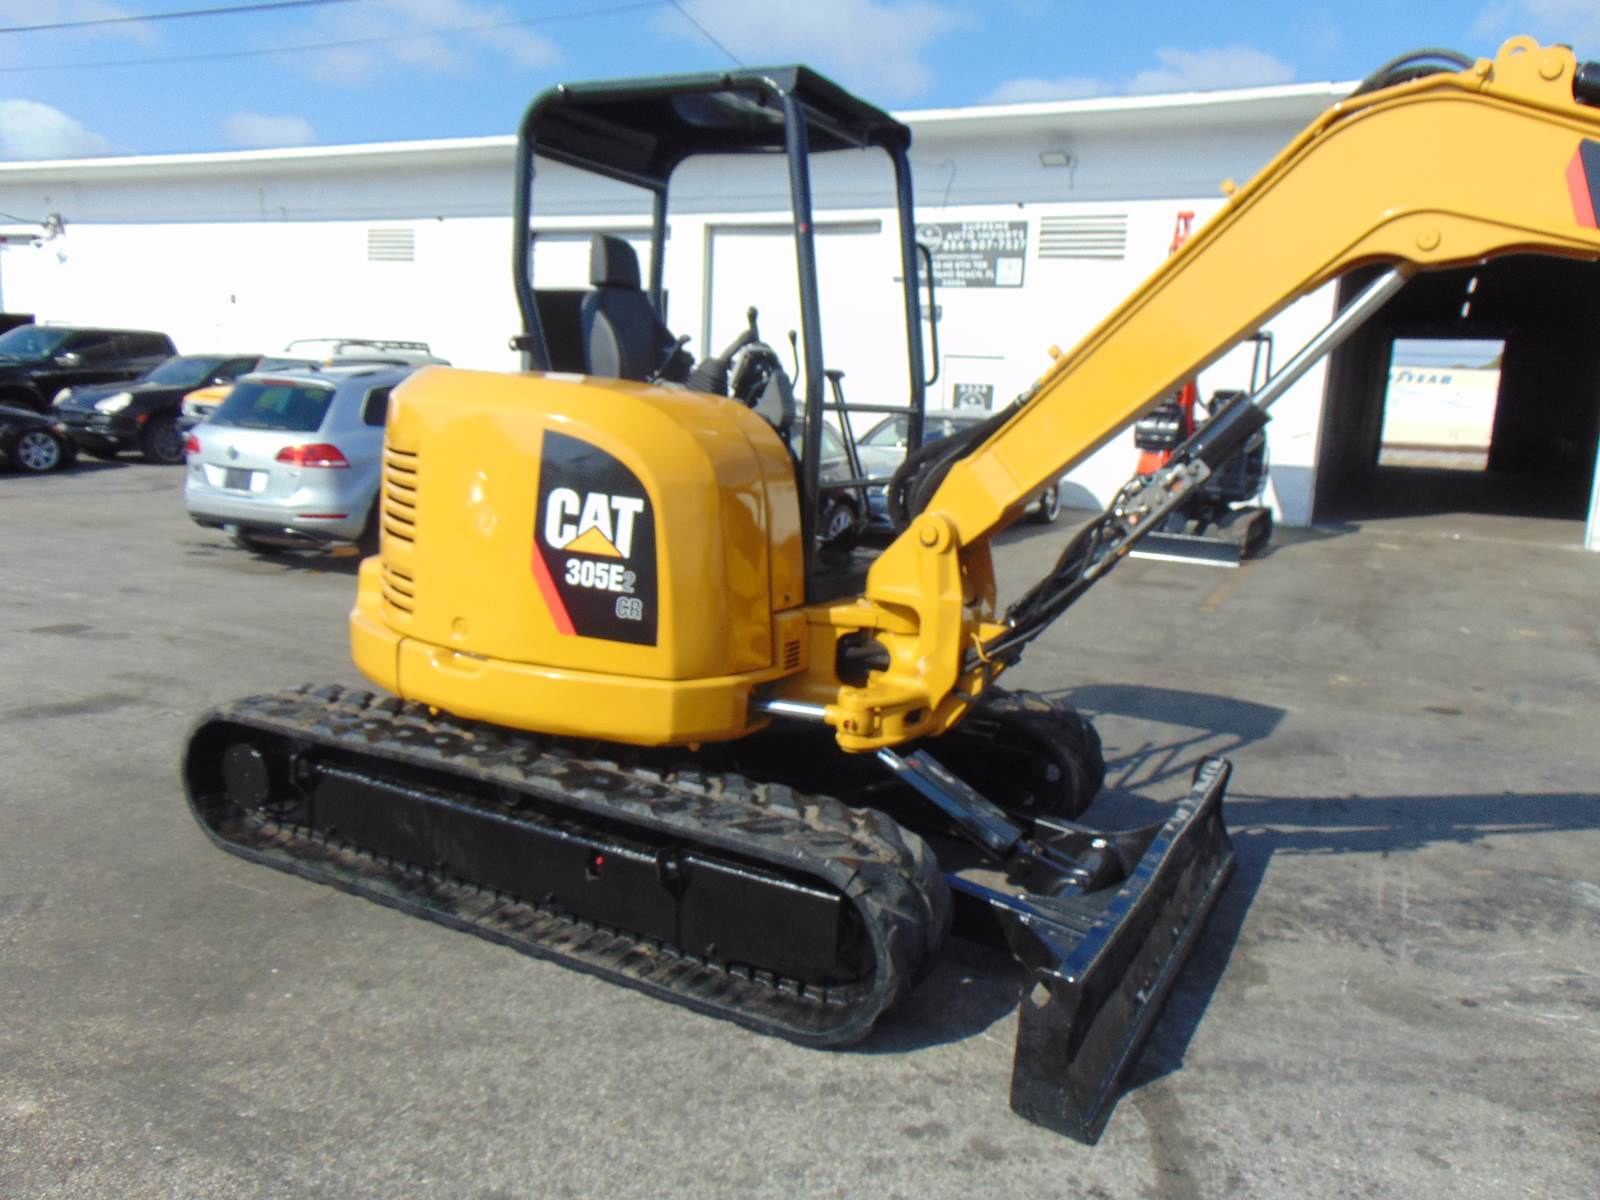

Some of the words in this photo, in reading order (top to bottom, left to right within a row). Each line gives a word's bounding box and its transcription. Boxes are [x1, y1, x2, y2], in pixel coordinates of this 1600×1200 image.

[945, 230, 976, 241] AUTO
[544, 486, 644, 560] CAT
[564, 557, 637, 594] 305E2
[614, 595, 643, 621] CR
